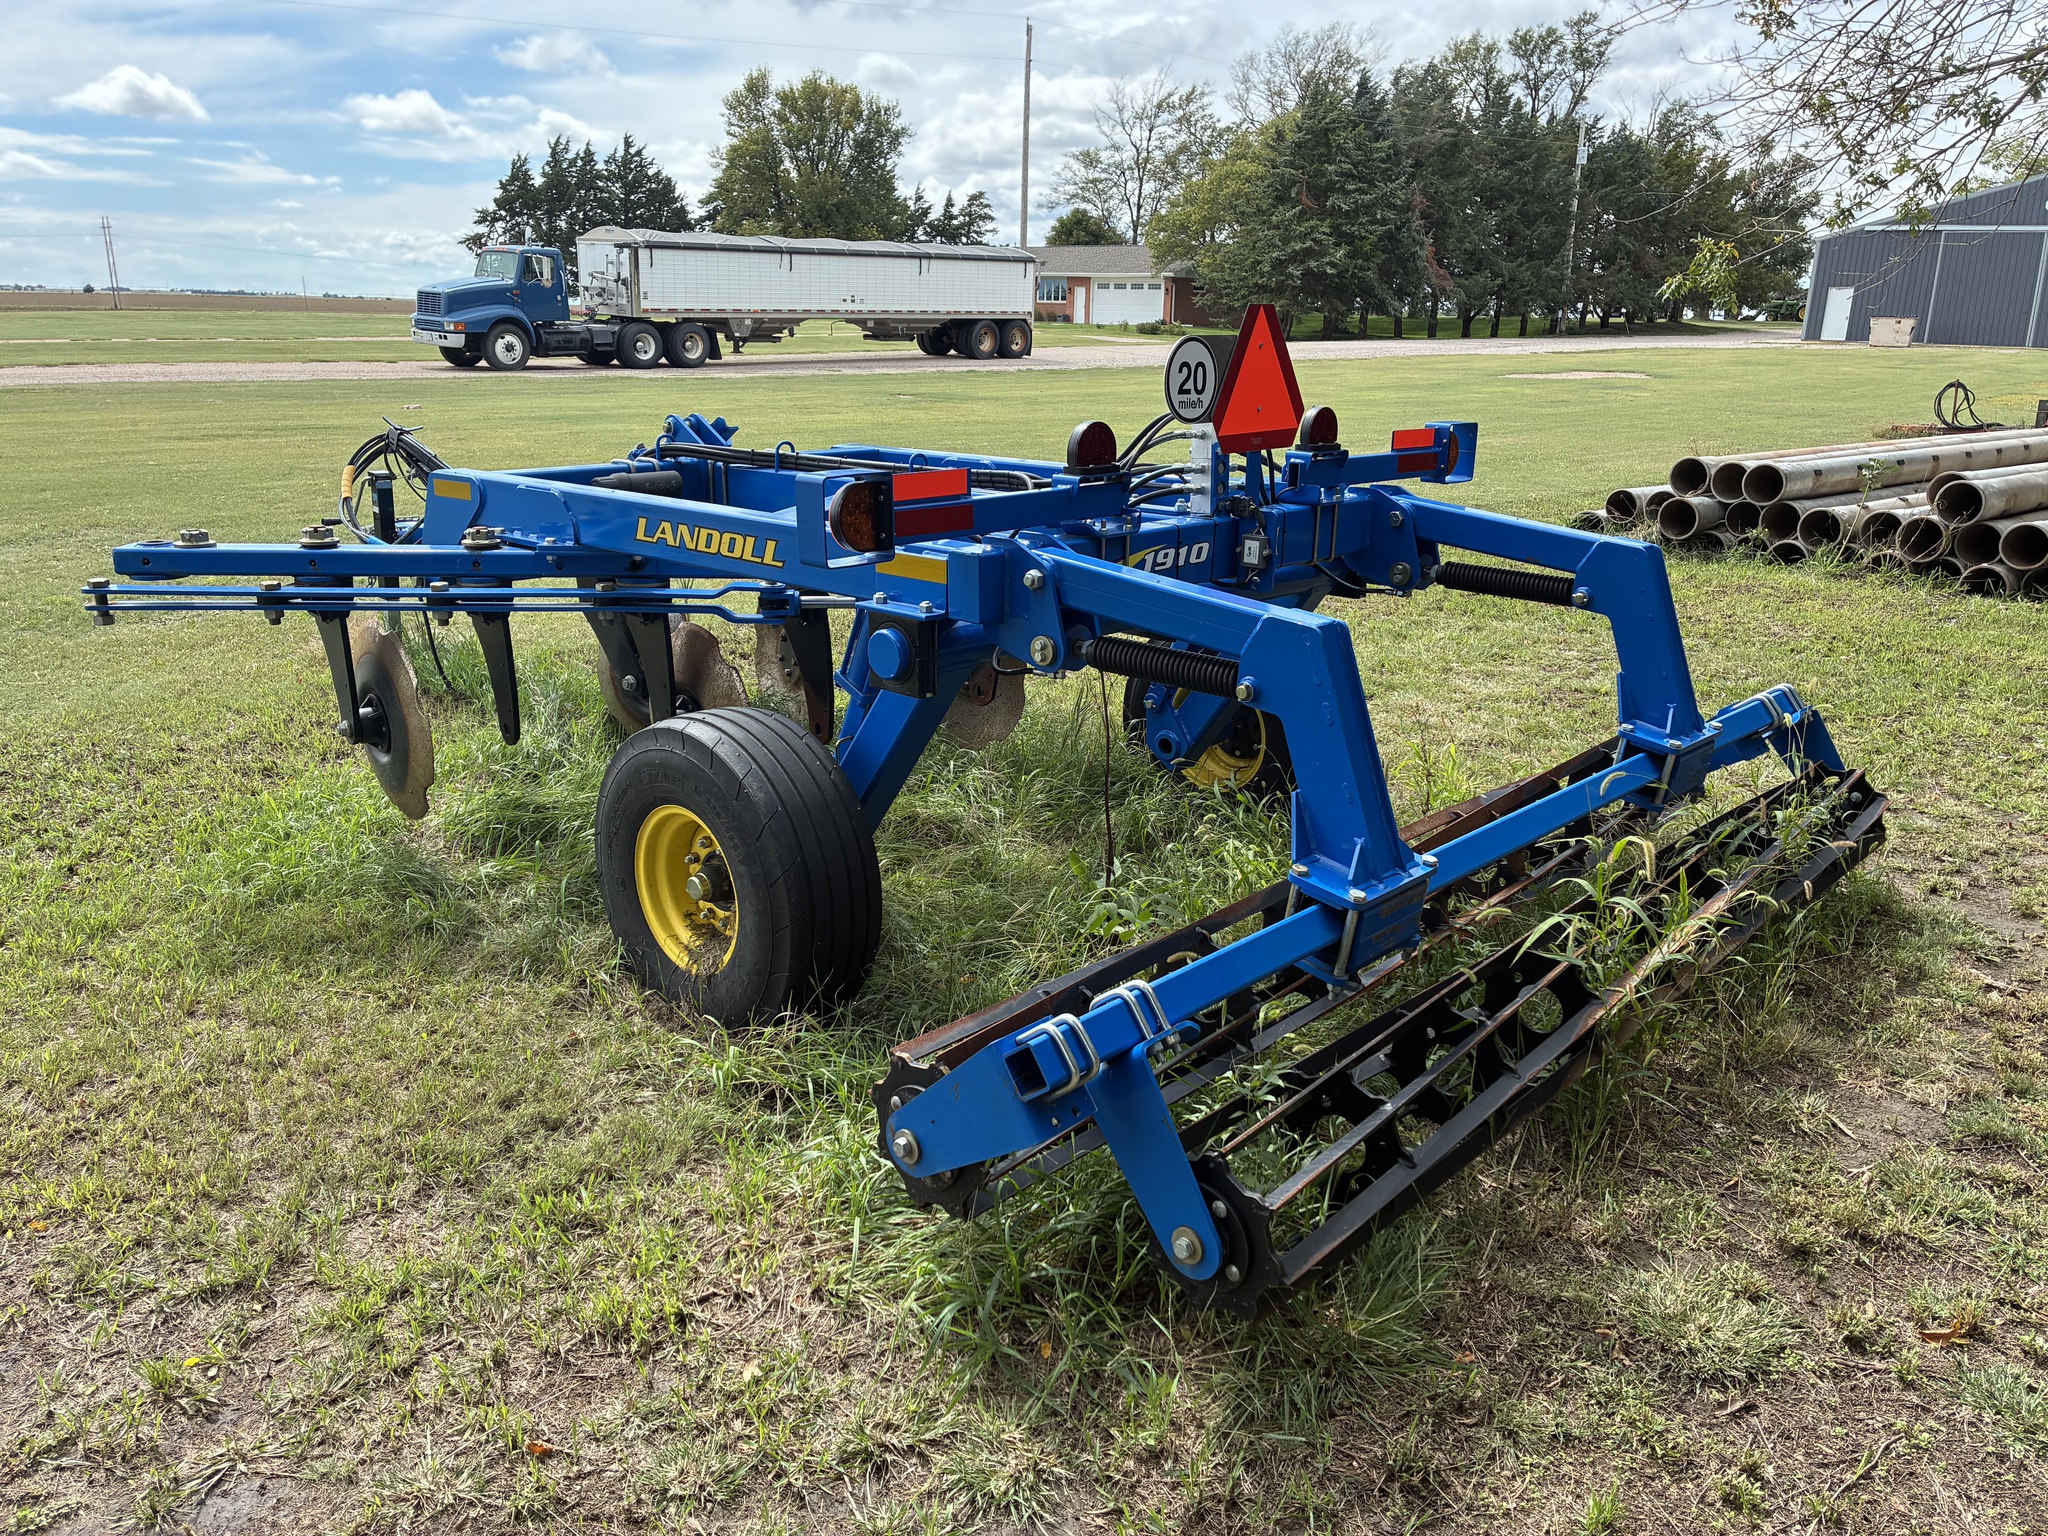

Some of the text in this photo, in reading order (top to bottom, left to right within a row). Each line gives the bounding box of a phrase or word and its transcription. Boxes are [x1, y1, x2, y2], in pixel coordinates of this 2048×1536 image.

[1177, 361, 1207, 396] 20
[1178, 397, 1203, 410] mile/h
[634, 516, 786, 569] LANDOLL
[1143, 542, 1210, 572] 1910
